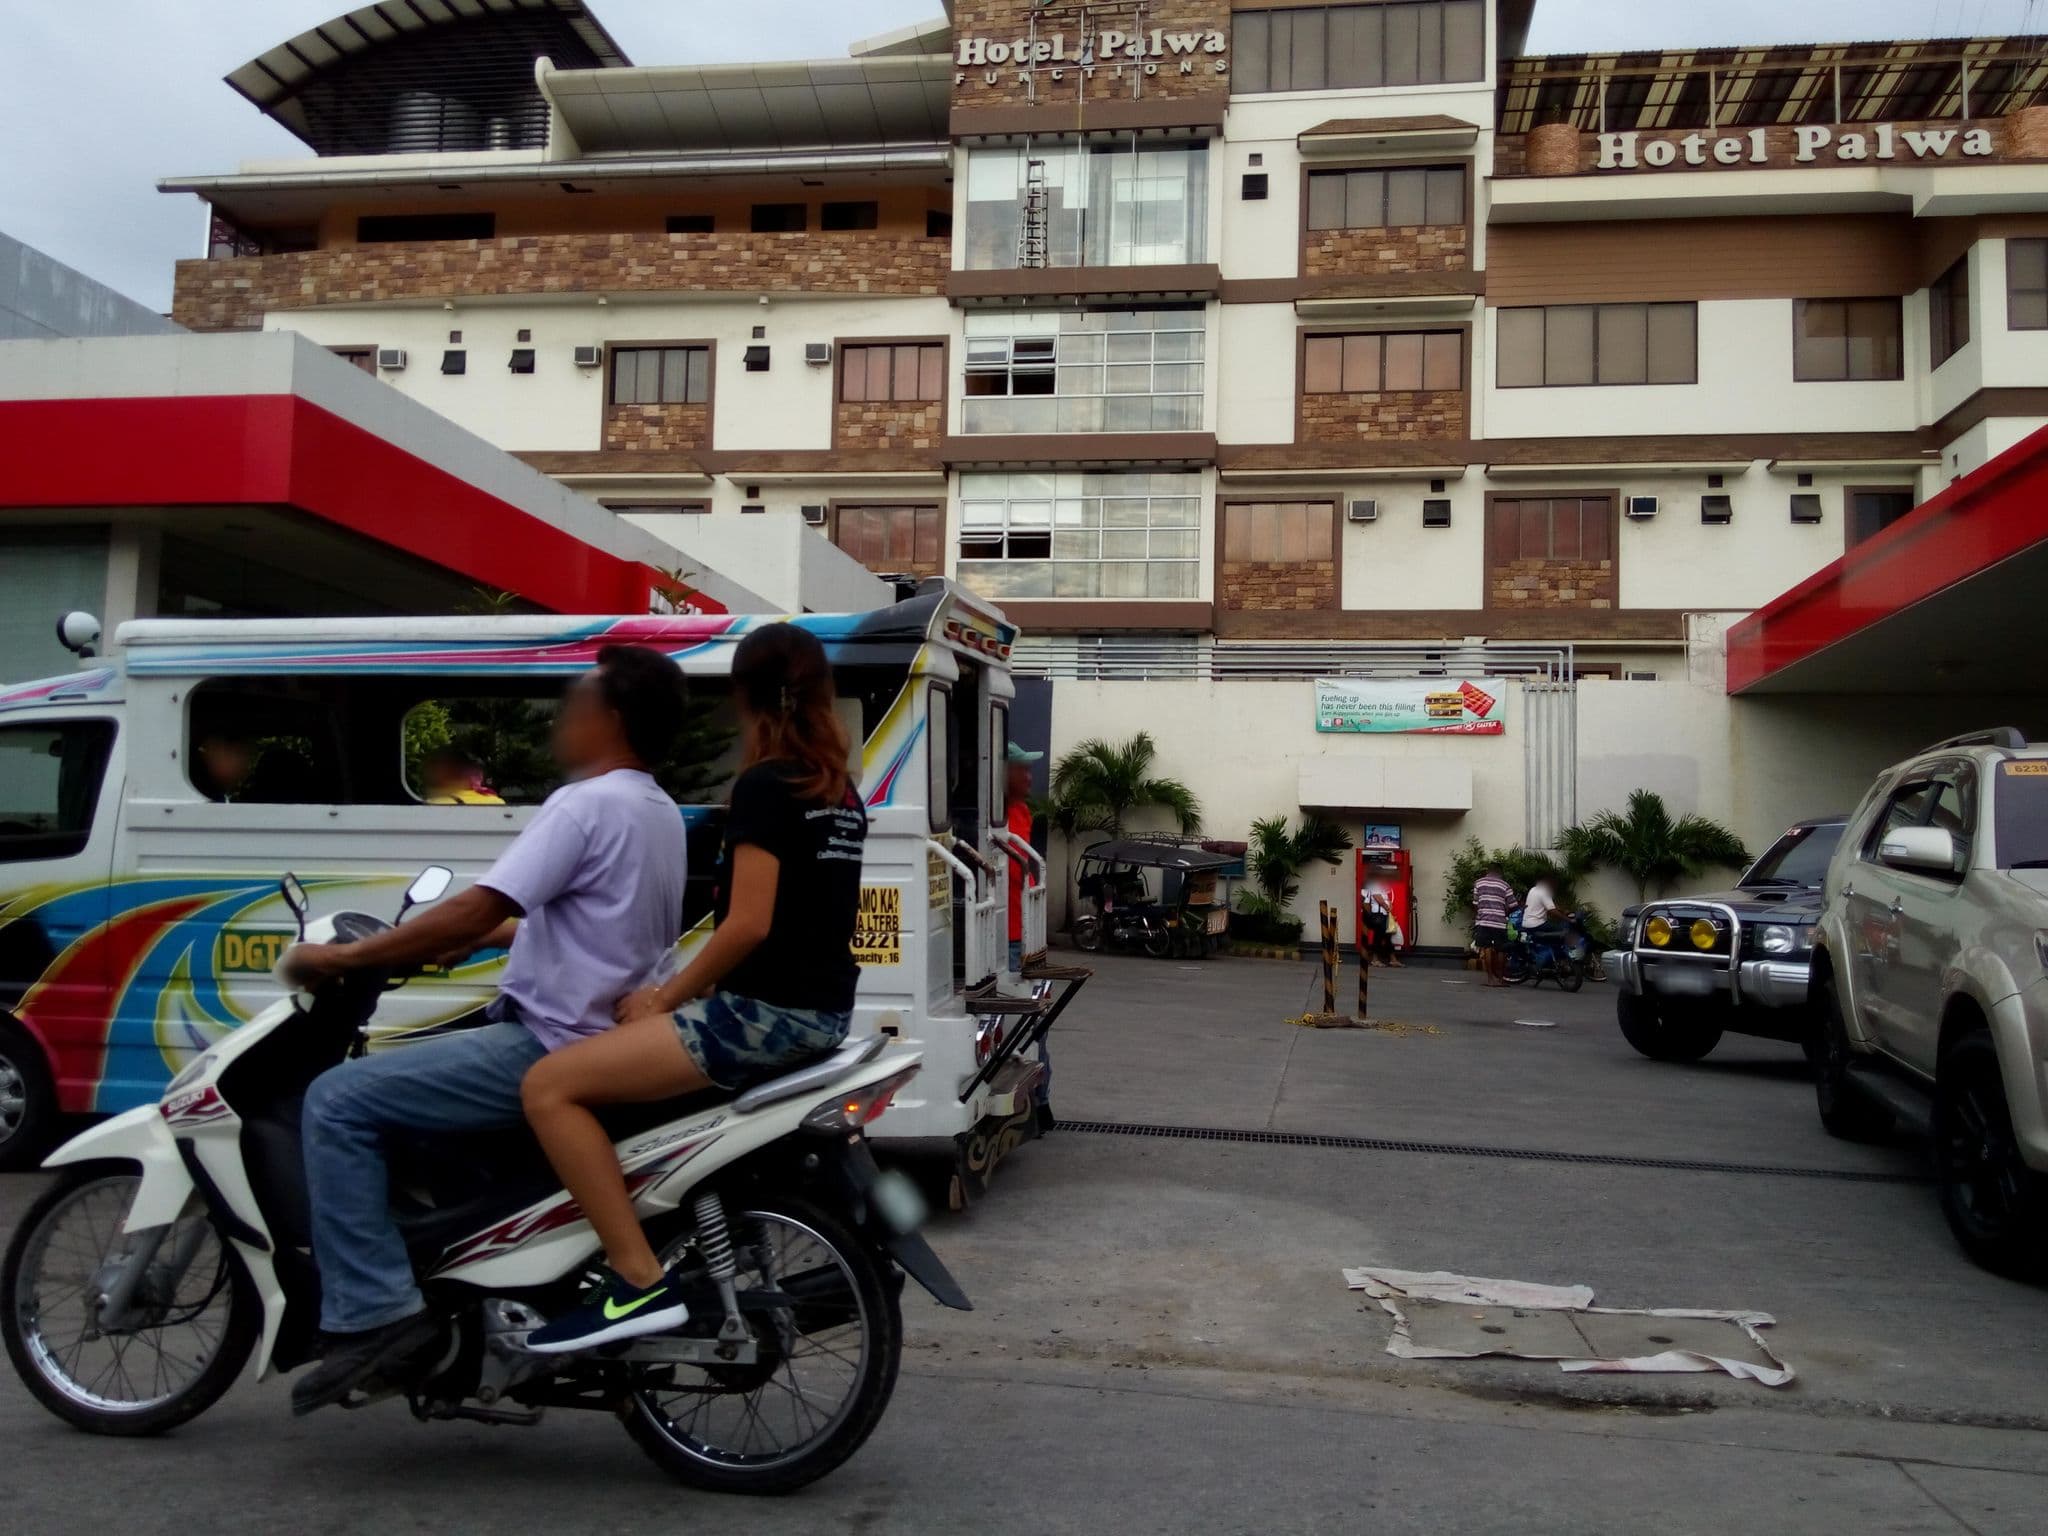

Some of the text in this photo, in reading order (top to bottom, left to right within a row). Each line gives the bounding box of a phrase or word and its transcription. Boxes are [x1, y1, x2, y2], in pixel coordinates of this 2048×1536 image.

[957, 28, 1227, 66] Hotel Palwa
[955, 59, 1227, 86] FUNCTIONS
[1597, 123, 1994, 169] Hotel Palwa
[1321, 694, 1347, 703] Fueling
[1359, 703, 1377, 711] been
[1379, 703, 1393, 711] this
[1394, 703, 1416, 712] filling
[880, 888, 899, 913] KA?
[867, 914, 899, 932] LTFRB
[889, 953, 899, 963] 16
[166, 1089, 206, 1113] SUZUKI
